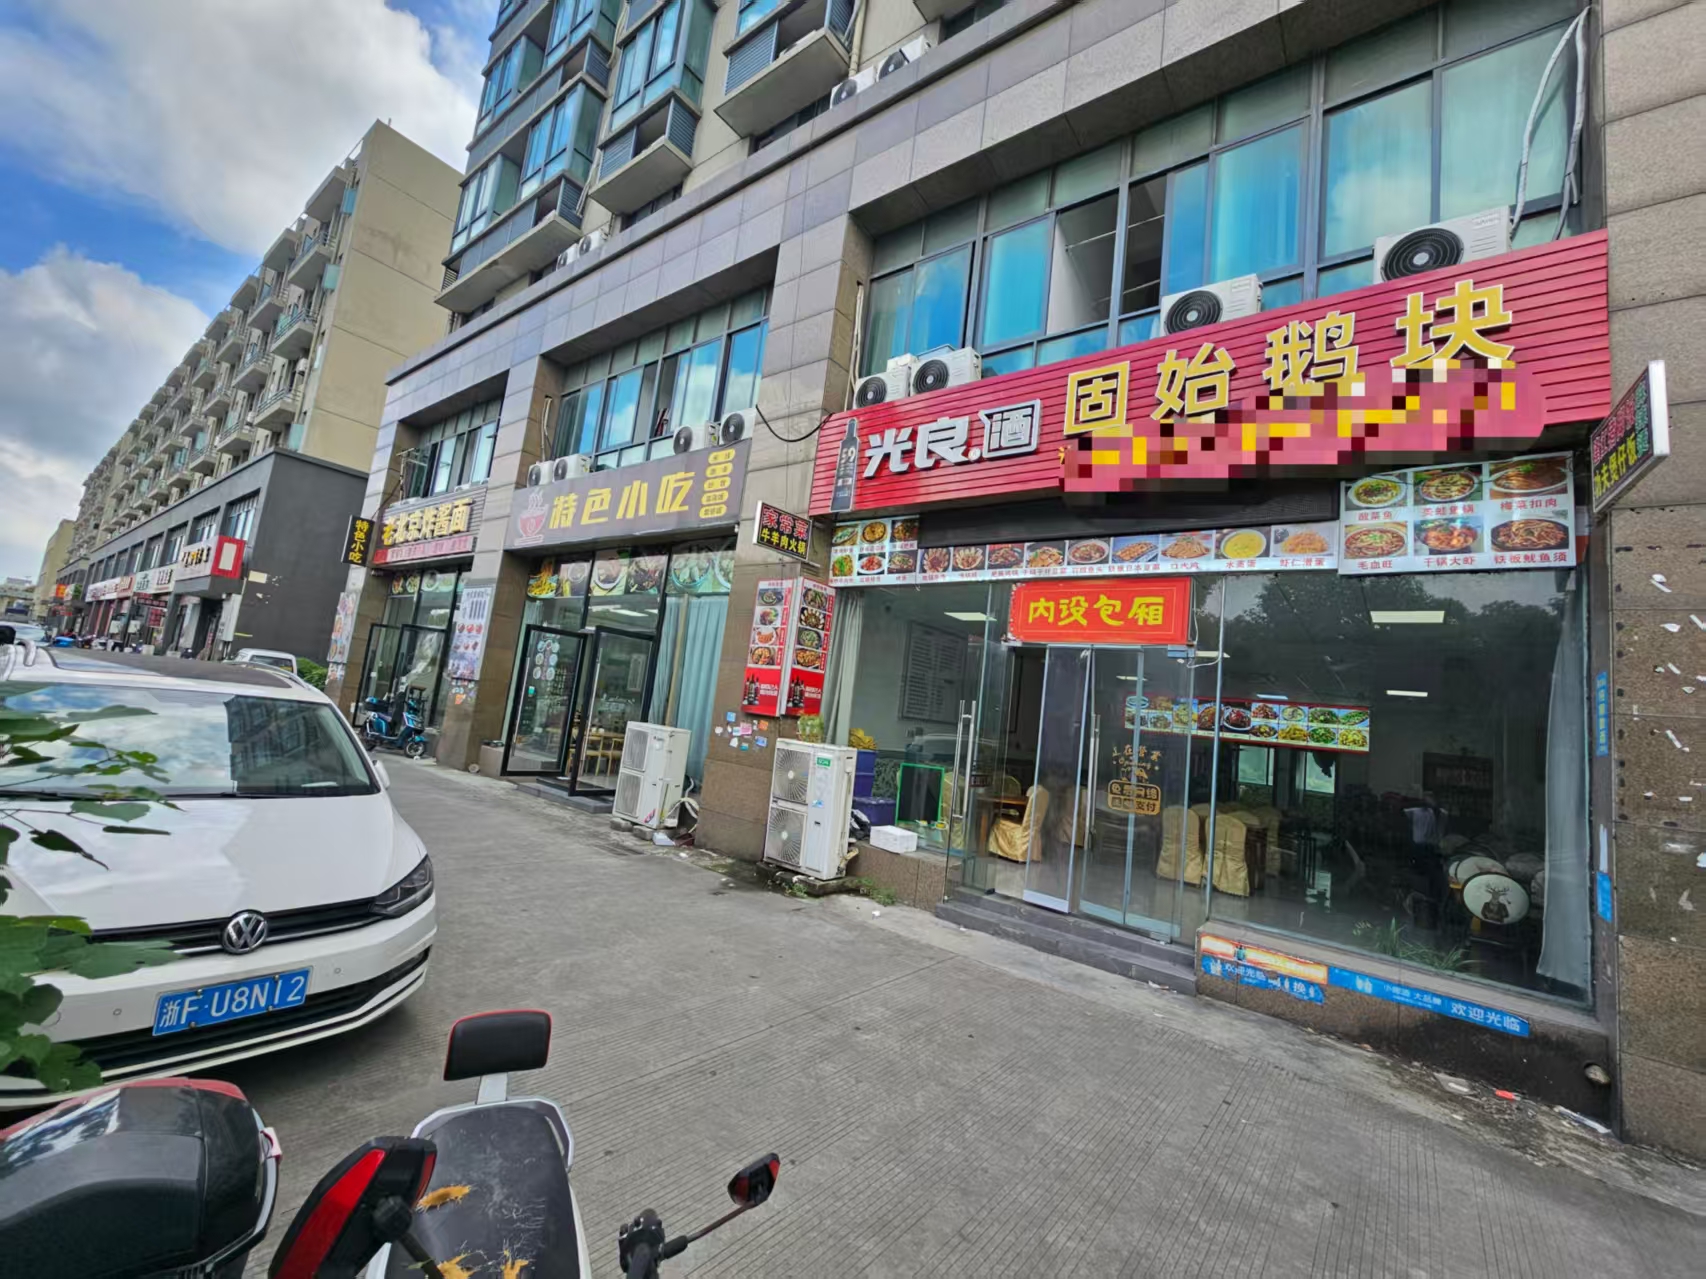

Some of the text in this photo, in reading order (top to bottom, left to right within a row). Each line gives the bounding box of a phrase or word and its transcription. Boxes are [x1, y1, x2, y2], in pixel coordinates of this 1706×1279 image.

[1063, 277, 1515, 436] 固始鹅块
[863, 400, 1042, 479] 光良酒
[841, 447, 856, 464] 59
[548, 469, 696, 530] 特色小吃
[1500, 498, 1557, 510] 梅菜扣肉
[381, 497, 473, 546] 老北京炸酱面
[761, 506, 809, 541] 家常菜
[1358, 511, 1393, 521] 酸菜鱼
[348, 519, 370, 564] 特色小吃
[760, 527, 807, 556] 牛羊肉火锅
[1357, 560, 1393, 570] 毛血旺
[1424, 555, 1476, 568] 干锅大虾
[1494, 551, 1568, 564] 铁板鱿鱼须
[1028, 593, 1165, 628] 内设包厢
[1450, 1002, 1521, 1033] 欢迎光临
